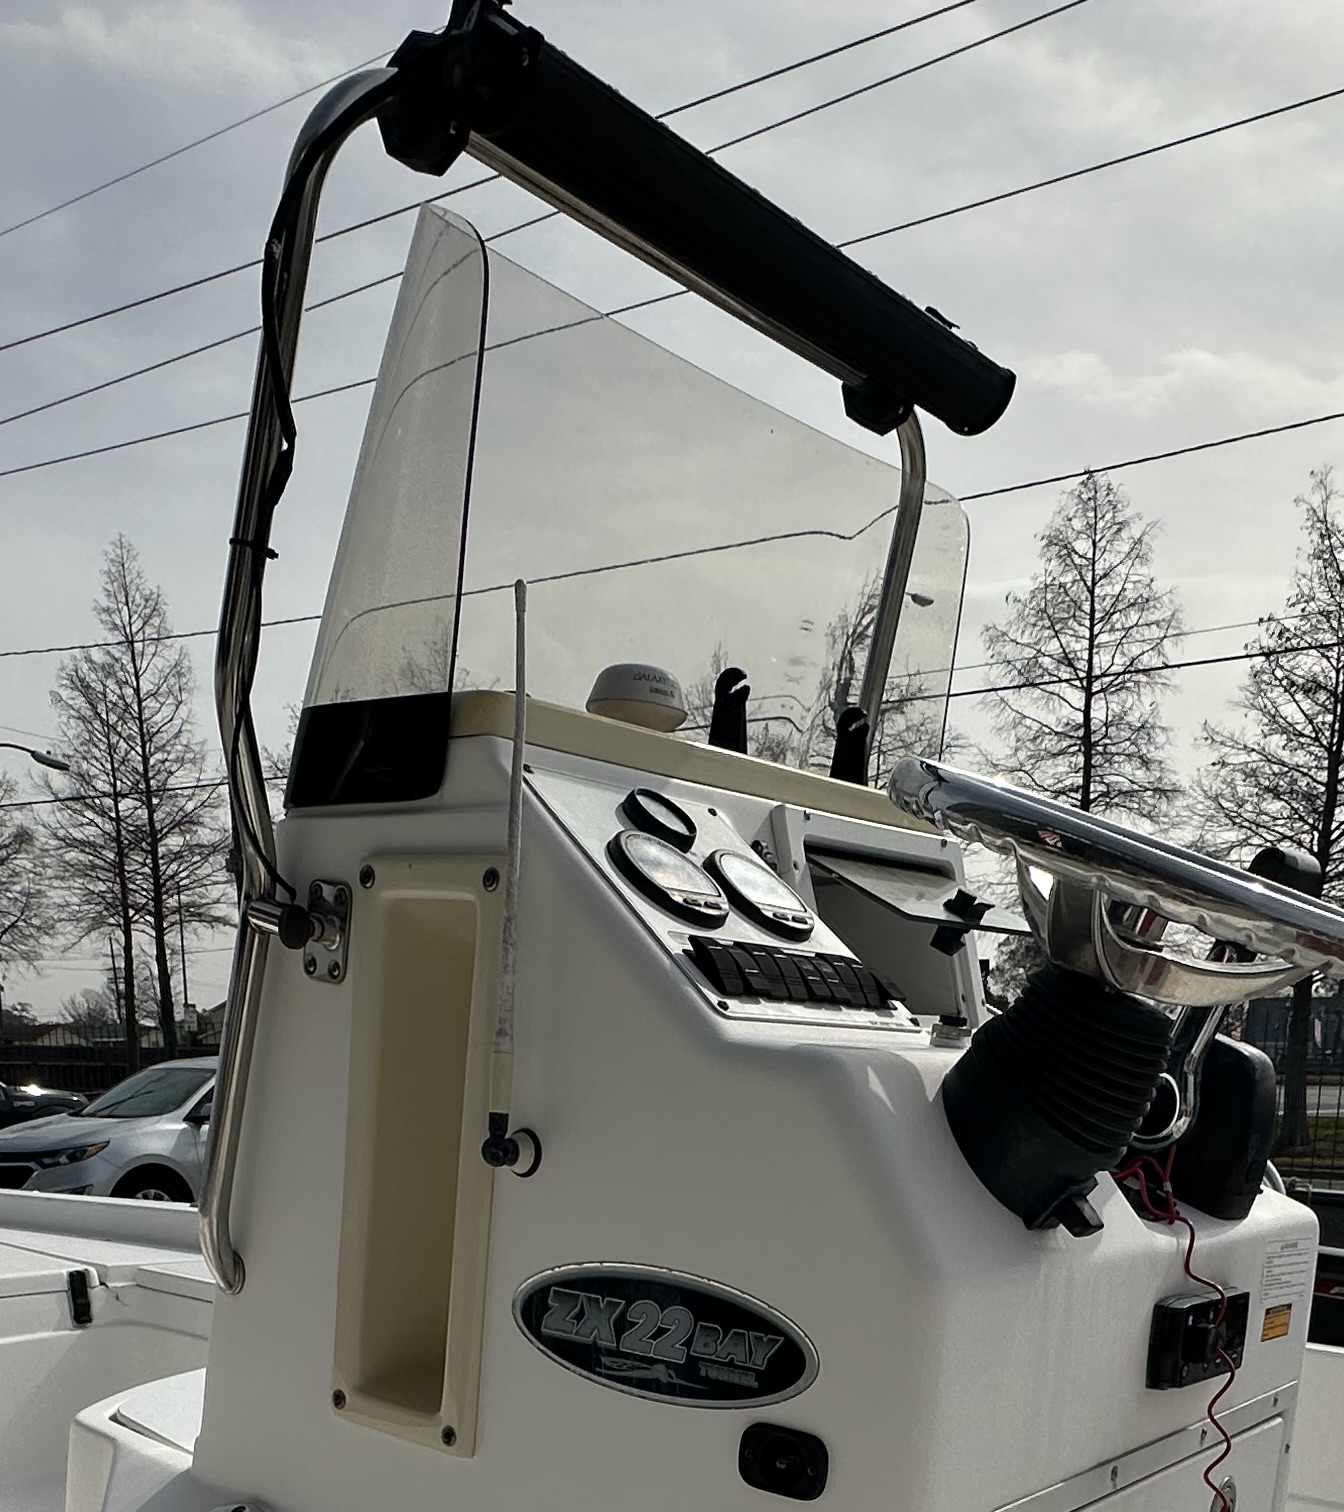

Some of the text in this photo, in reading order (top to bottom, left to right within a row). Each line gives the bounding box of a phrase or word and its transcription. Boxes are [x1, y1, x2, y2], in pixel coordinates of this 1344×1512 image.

[542, 1287, 784, 1370] ZX 22 BAY
